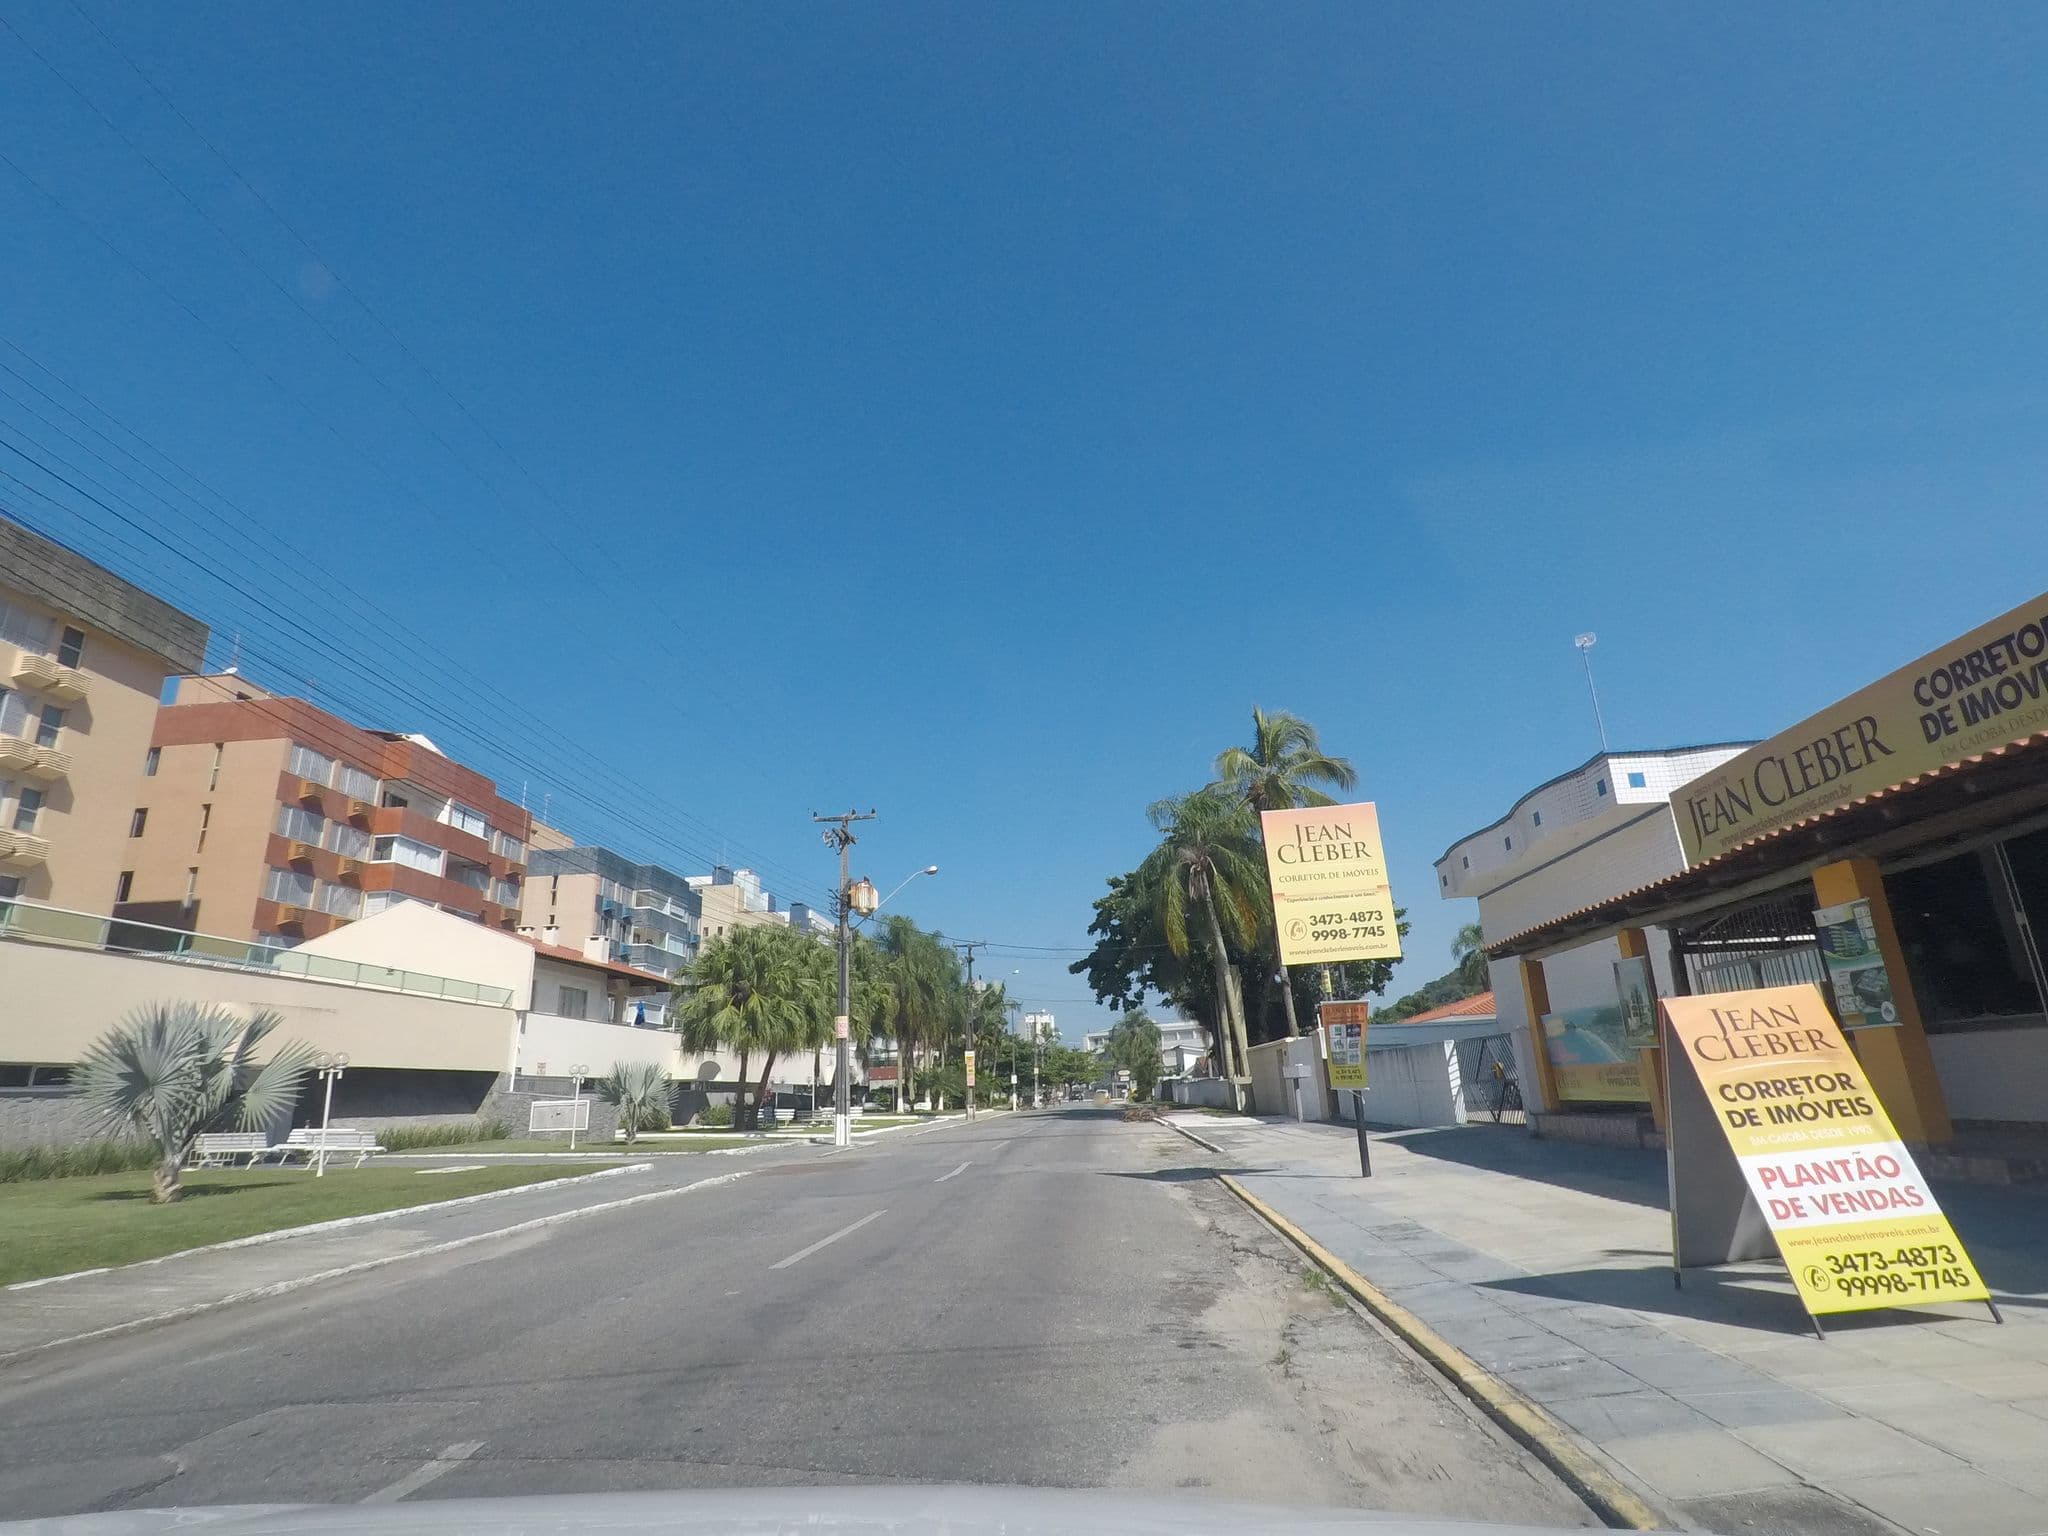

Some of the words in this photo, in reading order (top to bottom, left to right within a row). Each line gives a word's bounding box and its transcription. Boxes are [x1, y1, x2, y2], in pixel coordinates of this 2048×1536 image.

[1920, 703, 1959, 744] DE
[1687, 778, 1754, 855] JEAN
[1753, 715, 1897, 807] CLEBER
[1295, 822, 1353, 849] JEAN
[1277, 841, 1372, 864] CLEBER
[1278, 873, 1327, 883] CORRETOR
[1328, 871, 1341, 879] DE
[1342, 868, 1379, 878] IMÓVEIS
[1309, 910, 1384, 927] 3473-4873
[1311, 925, 1386, 942] 9998-7745
[1708, 1004, 1801, 1039] JEAN
[1693, 1028, 1838, 1062] CLEBER
[1718, 1072, 1857, 1103] CORRETOR
[1725, 1108, 1763, 1129] DE
[1765, 1096, 1874, 1125] IMÓVEIS
[1757, 1151, 1901, 1191] PLANTÃO
[1767, 1197, 1809, 1221] DE
[1809, 1185, 1925, 1216] VENDAS
[1825, 1244, 1958, 1275] 3473-4873
[1836, 1267, 1971, 1298] 99998-7745
